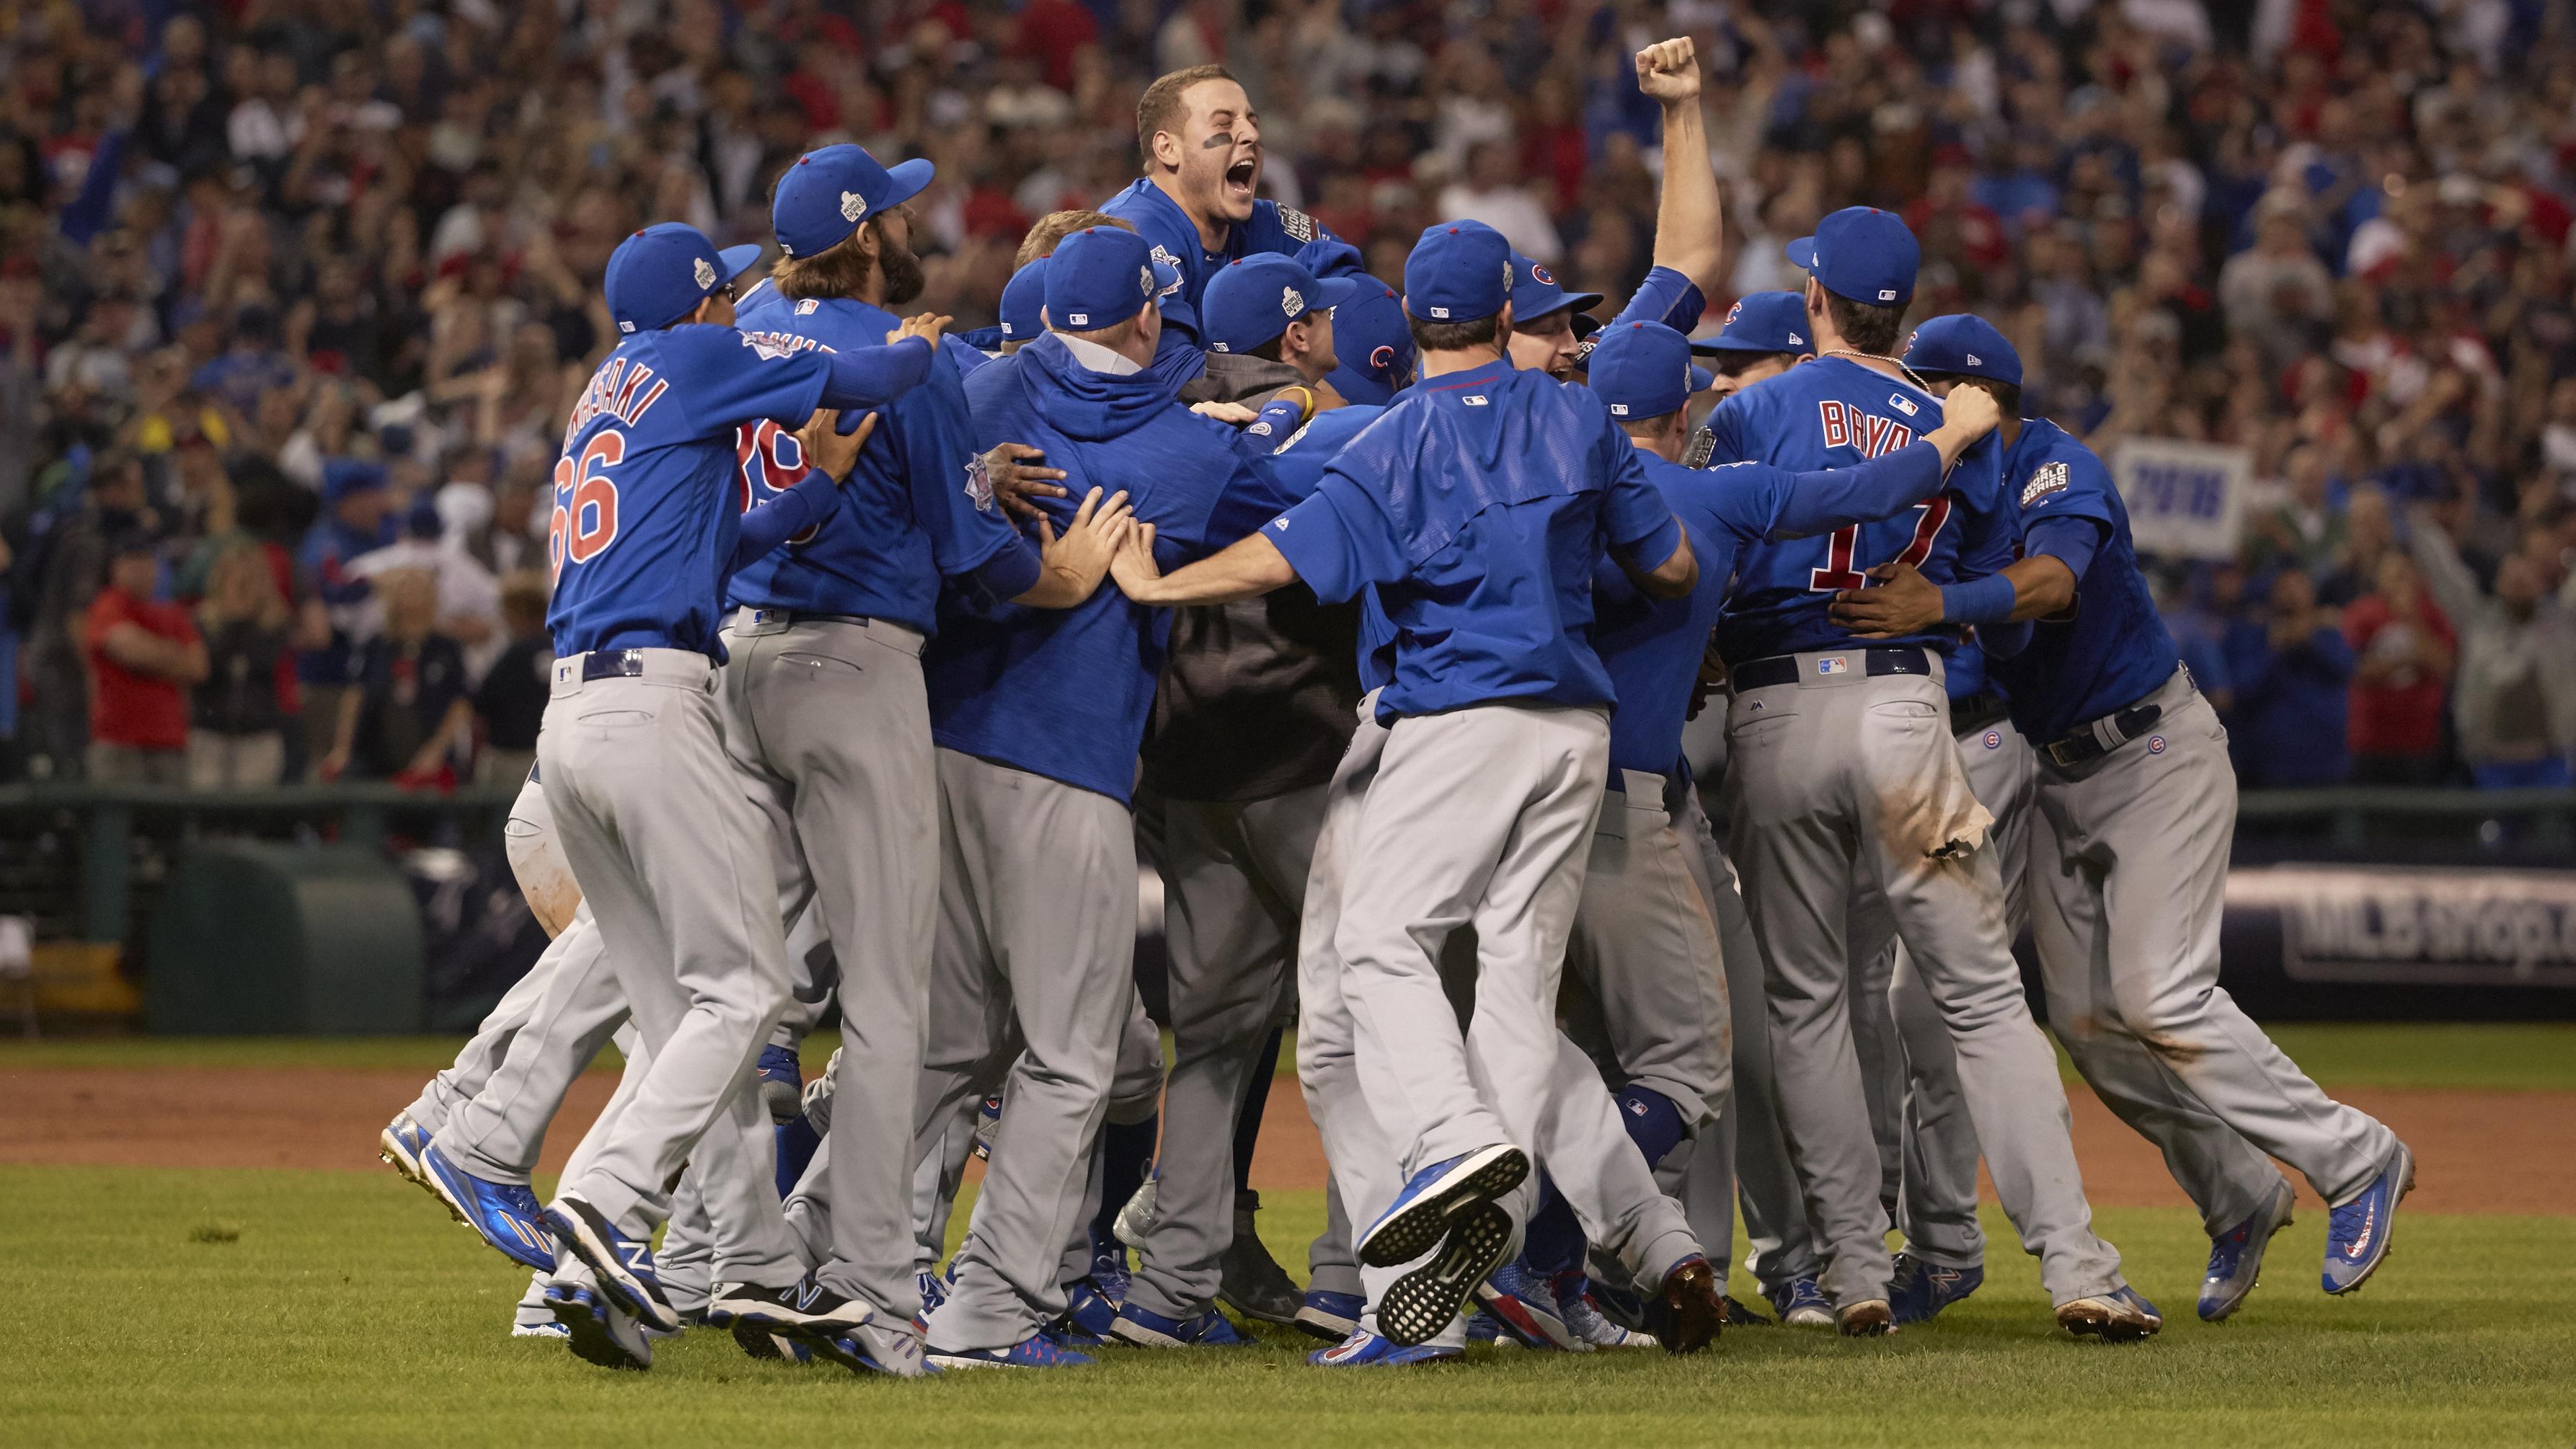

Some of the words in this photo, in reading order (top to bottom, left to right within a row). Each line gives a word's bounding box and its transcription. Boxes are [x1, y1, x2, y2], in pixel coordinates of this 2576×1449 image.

[843, 195, 861, 214] WORLD
[846, 200, 865, 220] SERIES
[1287, 209, 1299, 235] WOR
[1298, 213, 1312, 242] SERI
[1531, 264, 1555, 285] C
[1283, 293, 1301, 308] WORLD
[1285, 297, 1303, 314] SERIES
[1370, 345, 1394, 369] C
[1819, 400, 1925, 459] BRYA
[2022, 474, 2067, 505] SERIES
[2023, 466, 2066, 495] WORLD
[549, 429, 625, 590] 66
[1810, 495, 1952, 592] 17
